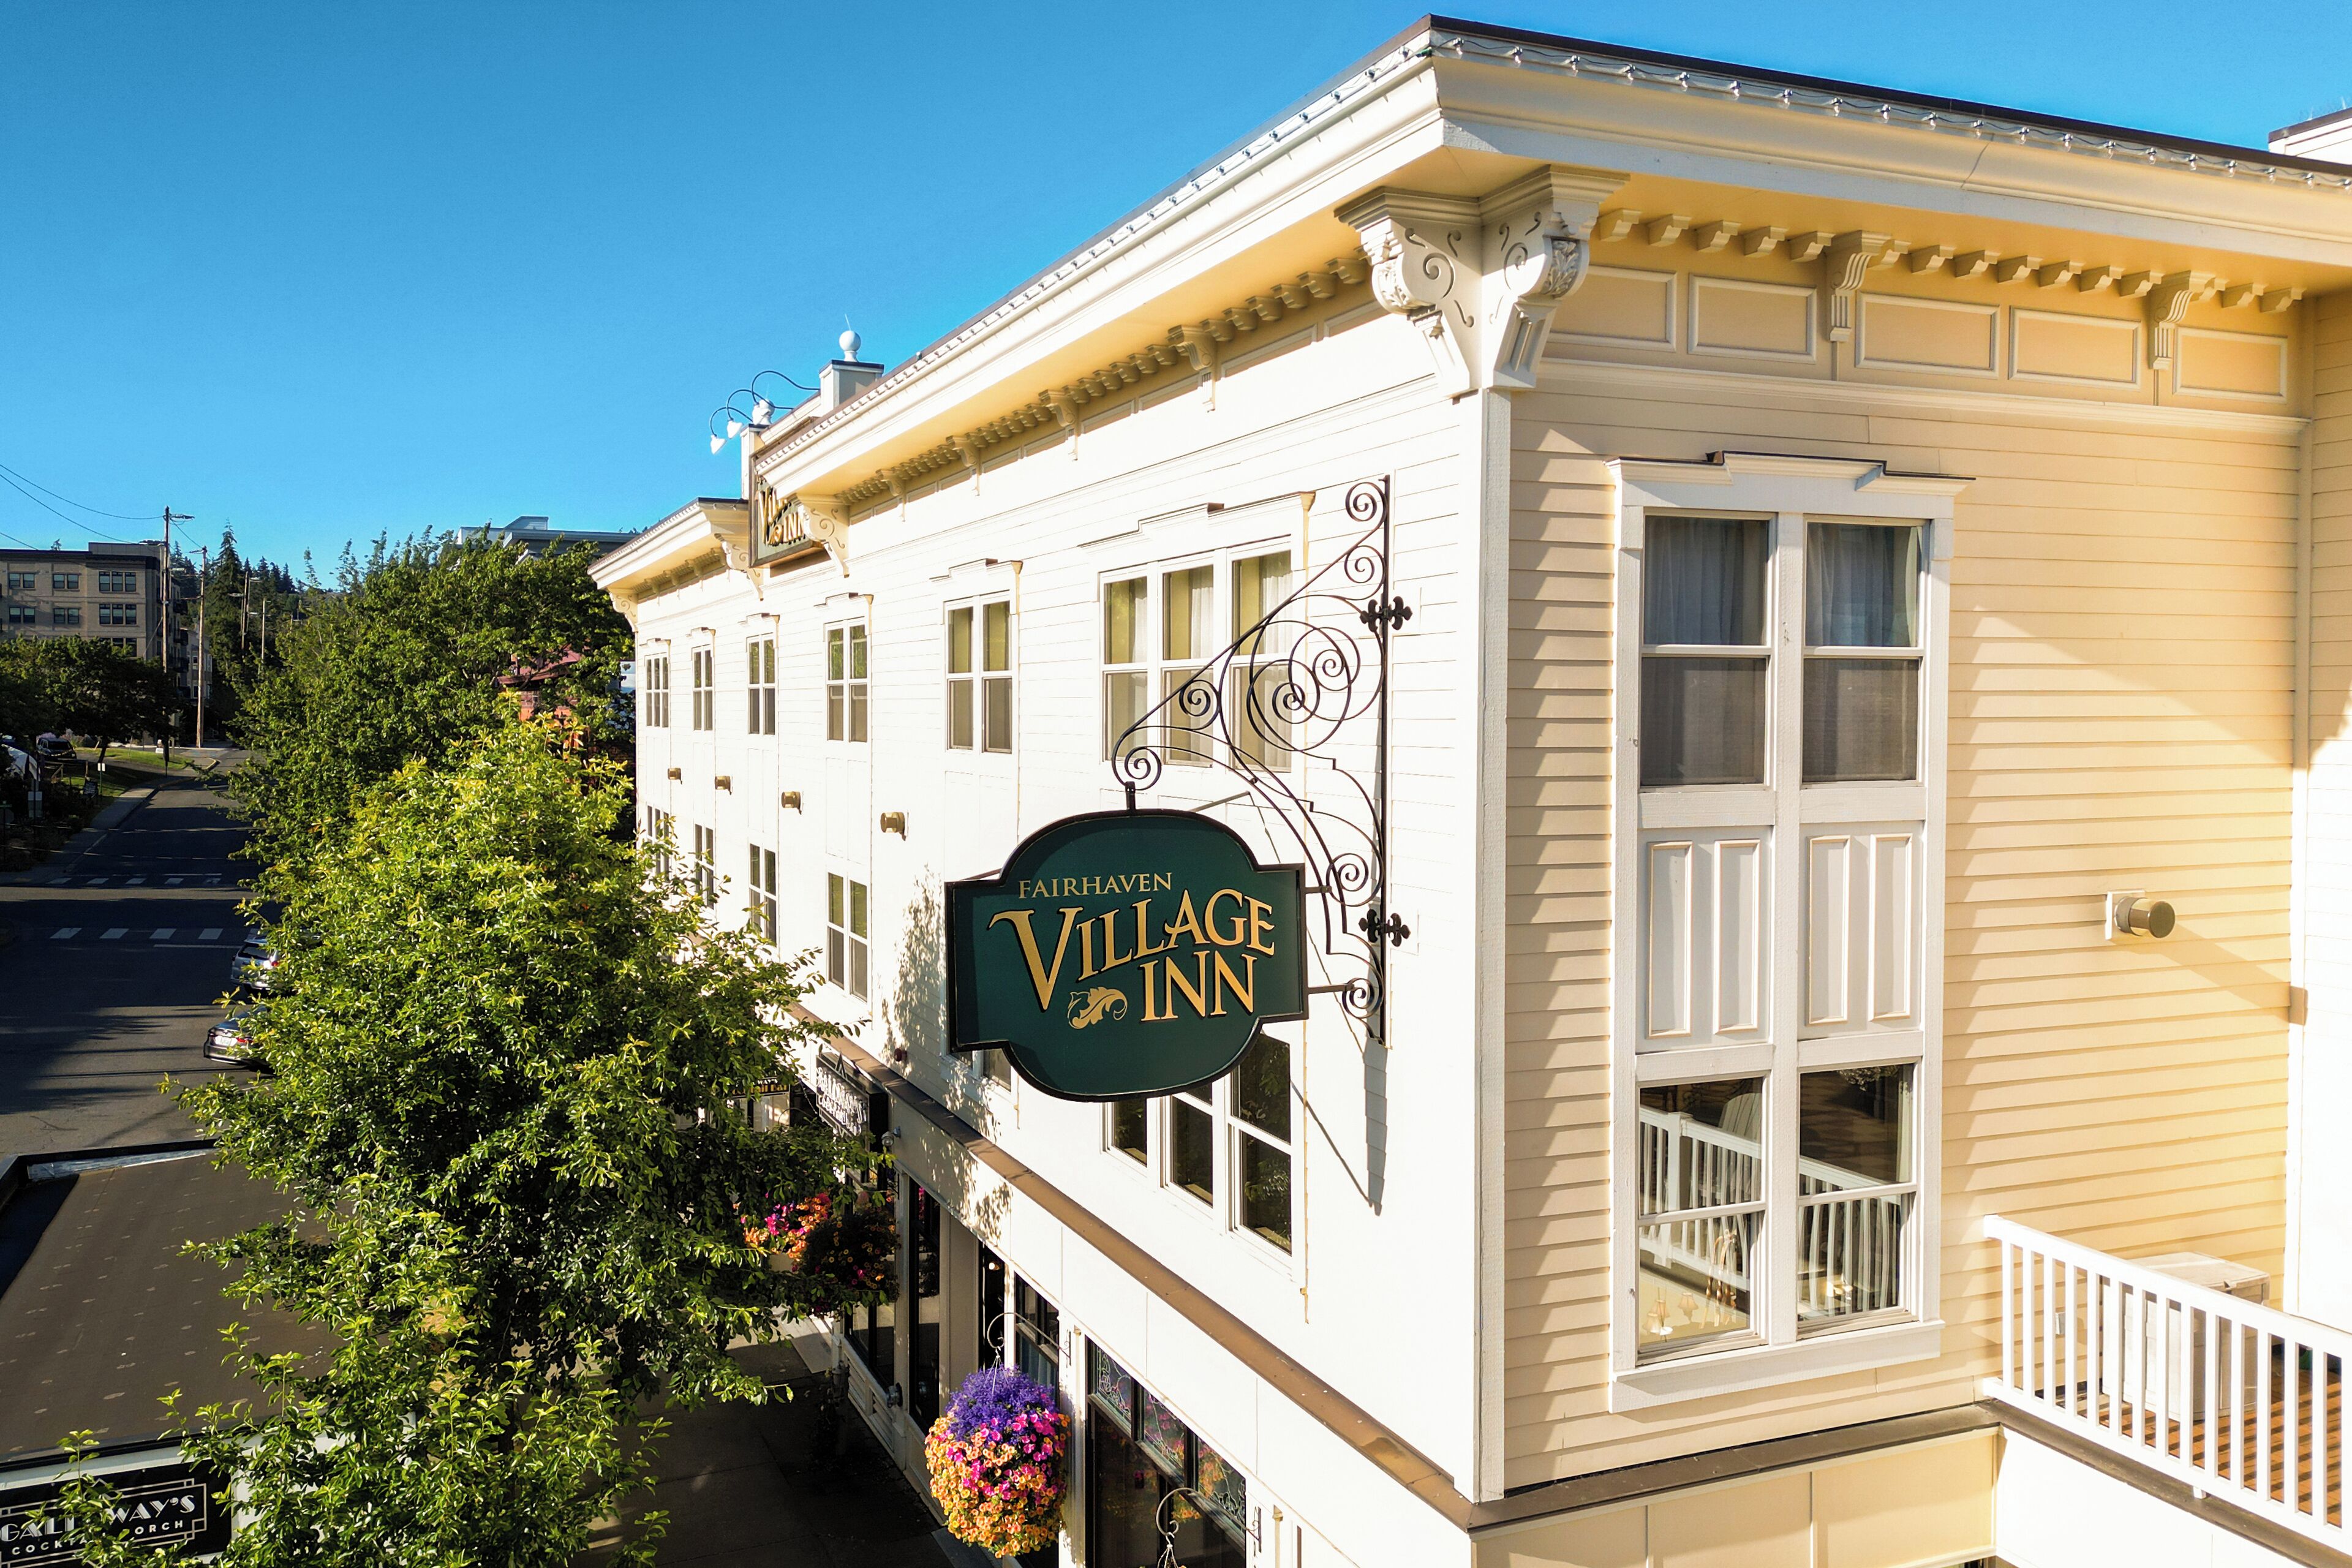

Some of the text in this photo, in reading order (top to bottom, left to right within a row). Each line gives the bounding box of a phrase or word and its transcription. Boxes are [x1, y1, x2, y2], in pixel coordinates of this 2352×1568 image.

[1019, 872, 1172, 899] FAIRHAVEN
[988, 888, 1275, 1010] VILLAGE
[1140, 950, 1257, 1022] INN
[0, 1495, 195, 1542] GALLWAY'S
[12, 1520, 183, 1555] COCKTA ORCH
